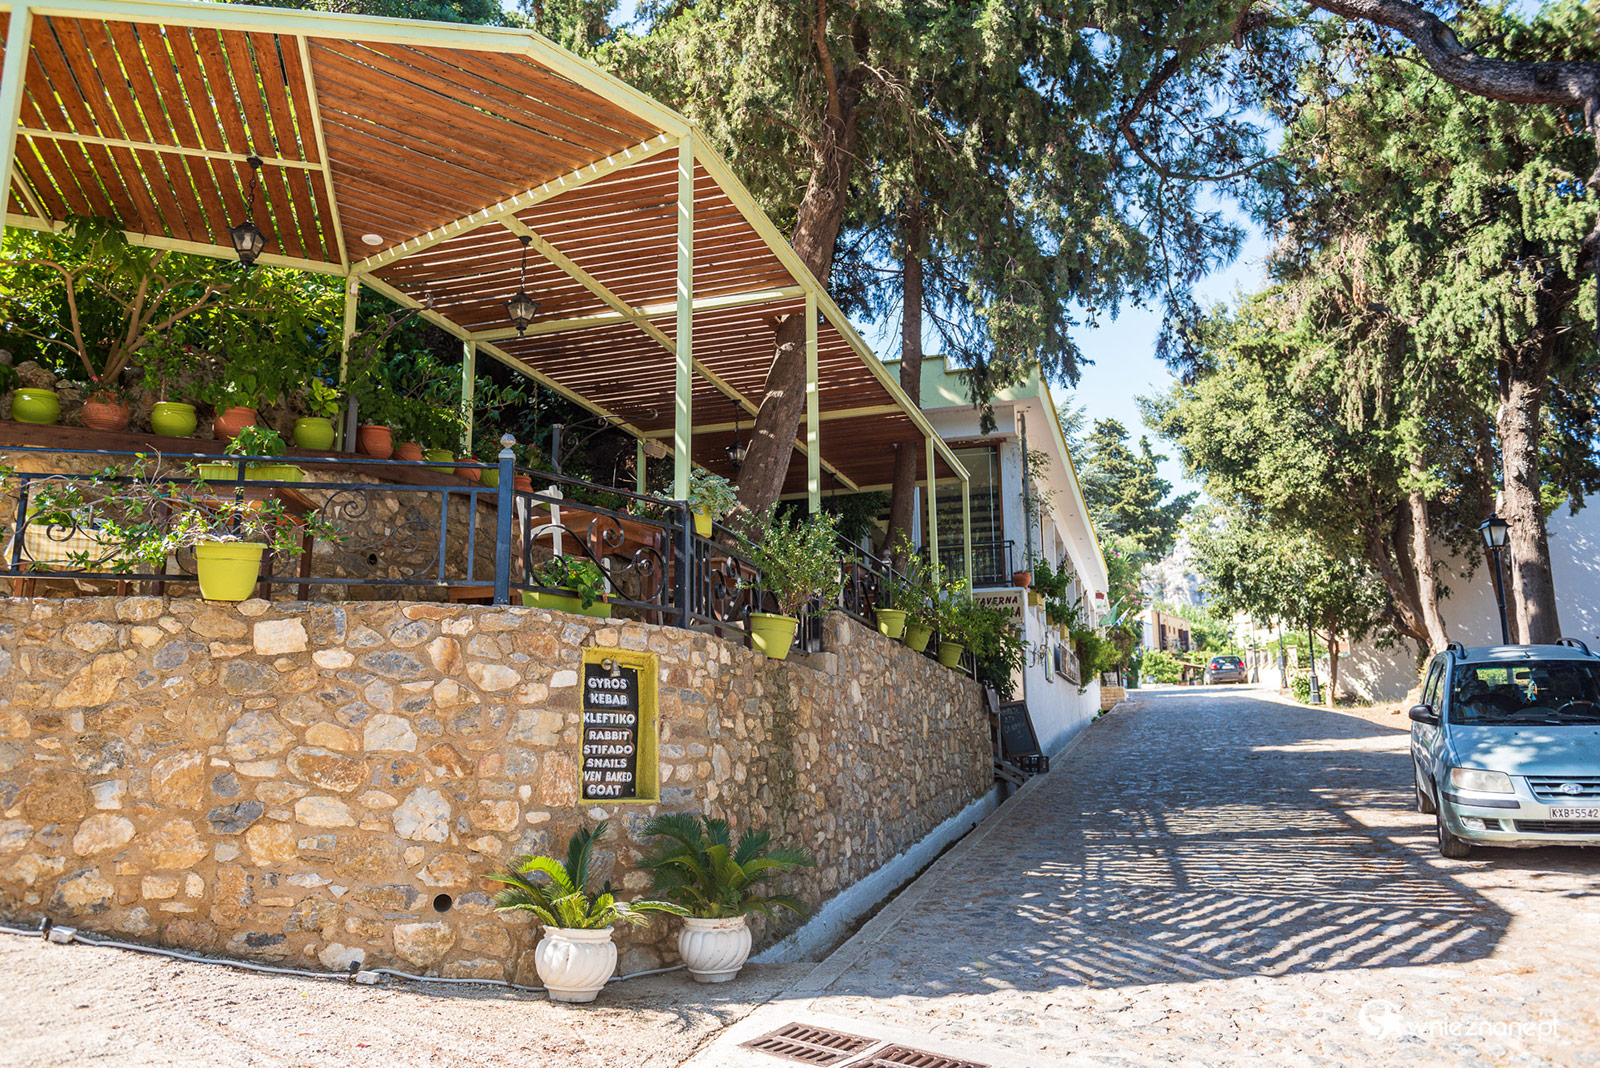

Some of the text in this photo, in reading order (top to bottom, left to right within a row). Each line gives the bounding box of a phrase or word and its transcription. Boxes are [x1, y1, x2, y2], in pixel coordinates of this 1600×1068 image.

[587, 677, 627, 690] GYROS
[590, 692, 627, 705] KEBAB
[583, 712, 635, 725] KLEFTIKO
[588, 730, 630, 740] RABBIT
[583, 744, 633, 755] STIFADO
[586, 757, 627, 768] SNAILS
[583, 770, 632, 782] VEN BAKED
[587, 784, 621, 796] GOAT
